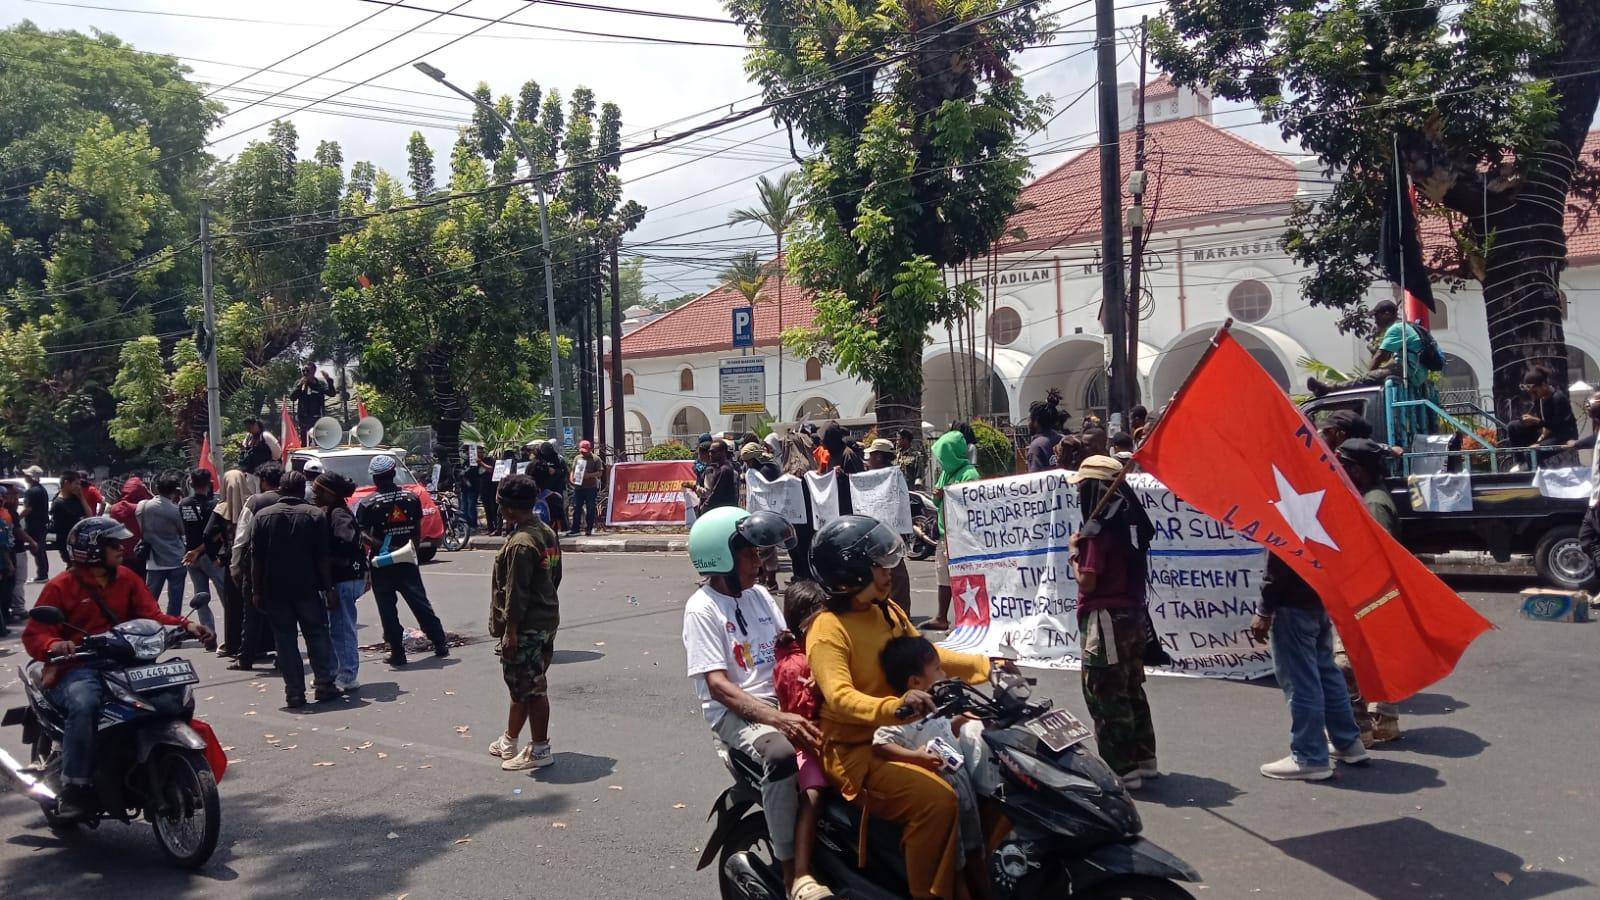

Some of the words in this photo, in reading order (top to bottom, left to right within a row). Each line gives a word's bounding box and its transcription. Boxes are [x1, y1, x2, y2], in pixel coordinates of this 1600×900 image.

[973, 269, 1050, 288] ENGADILAN
[736, 312, 750, 335] P
[962, 483, 1006, 506] FORUM
[1009, 473, 1076, 497] SOLIDA
[967, 503, 1022, 532] PELAJAR
[983, 530, 996, 548] DI
[1154, 517, 1184, 541] AR
[1150, 568, 1251, 589] AGREEMENT
[1043, 627, 1079, 648] TAN
[1159, 632, 1180, 652] AT
[1189, 630, 1238, 649] DAN
